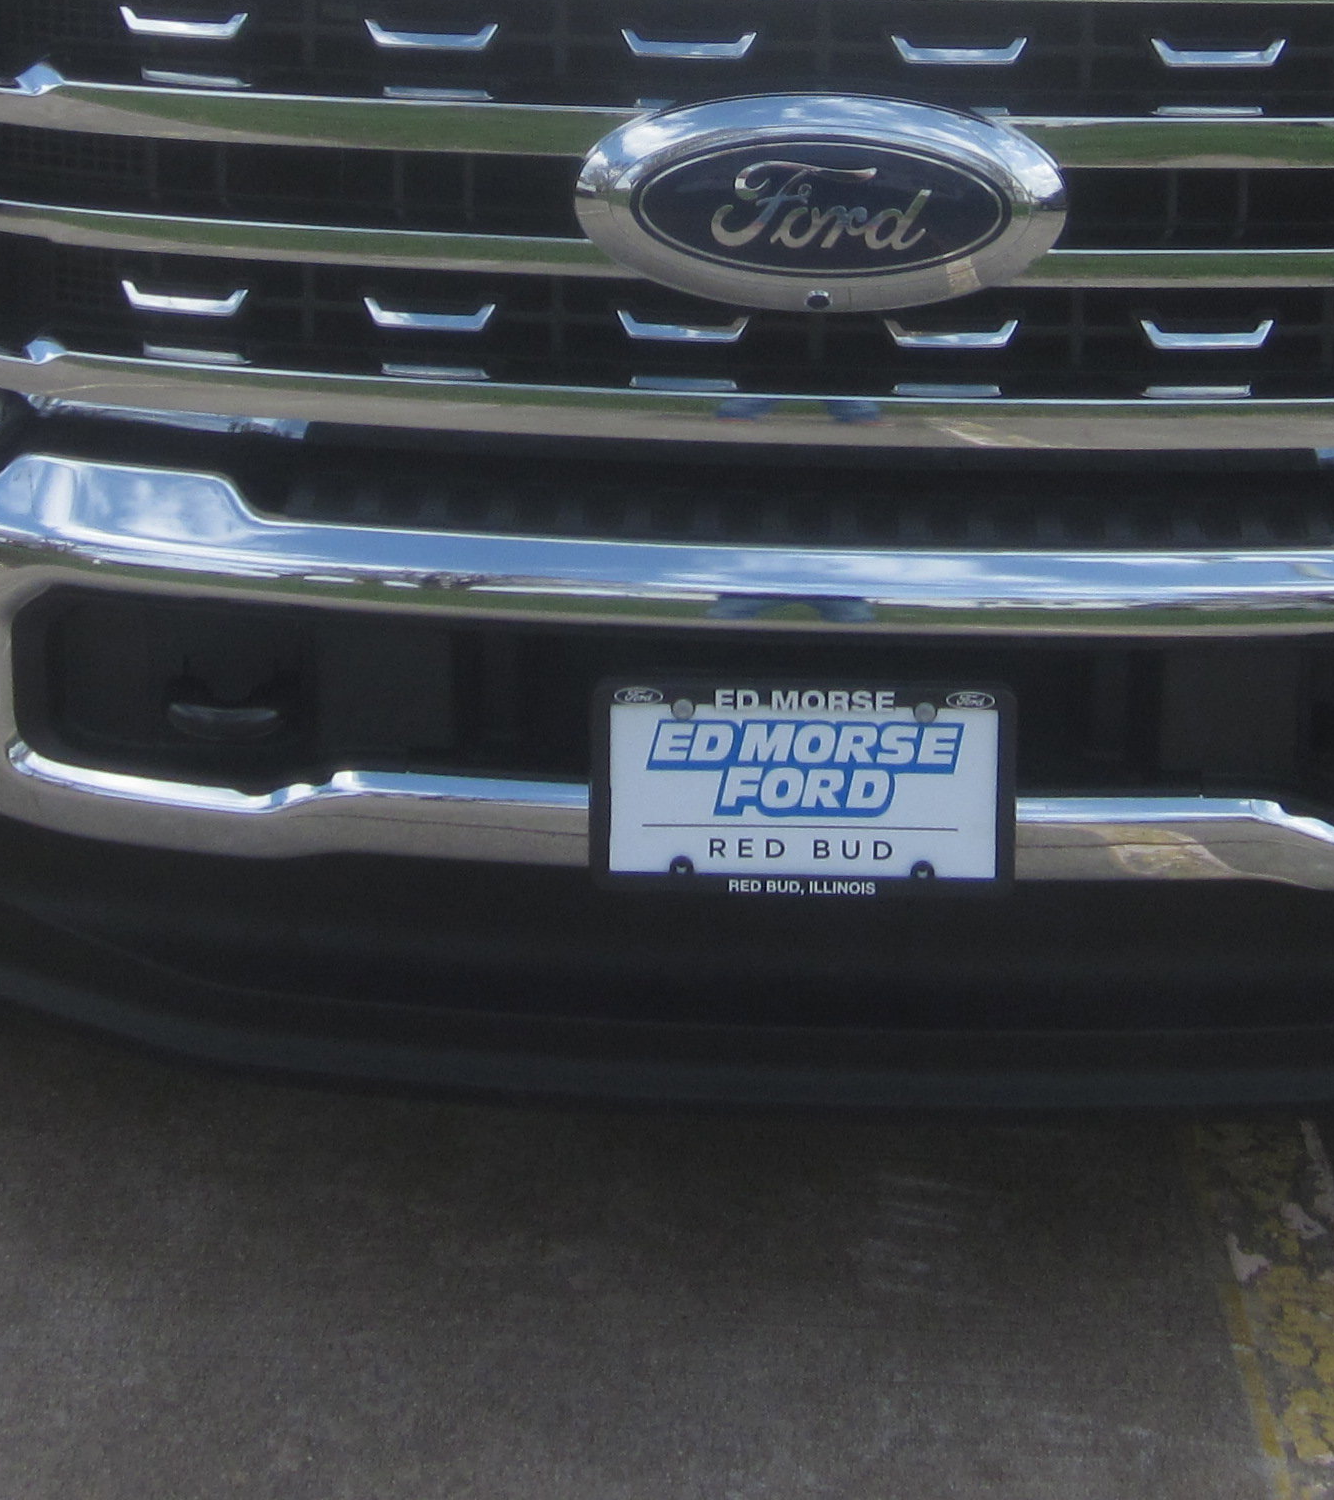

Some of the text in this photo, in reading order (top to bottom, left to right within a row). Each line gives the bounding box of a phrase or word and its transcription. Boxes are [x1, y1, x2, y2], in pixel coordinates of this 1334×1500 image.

[711, 160, 929, 251] Ford
[715, 689, 896, 713] ED MORSE
[648, 720, 963, 771] ED MORSE
[716, 765, 892, 815] FORD
[709, 838, 893, 861] RED BUD
[728, 878, 877, 896] RED BUD, ILLINOIS
